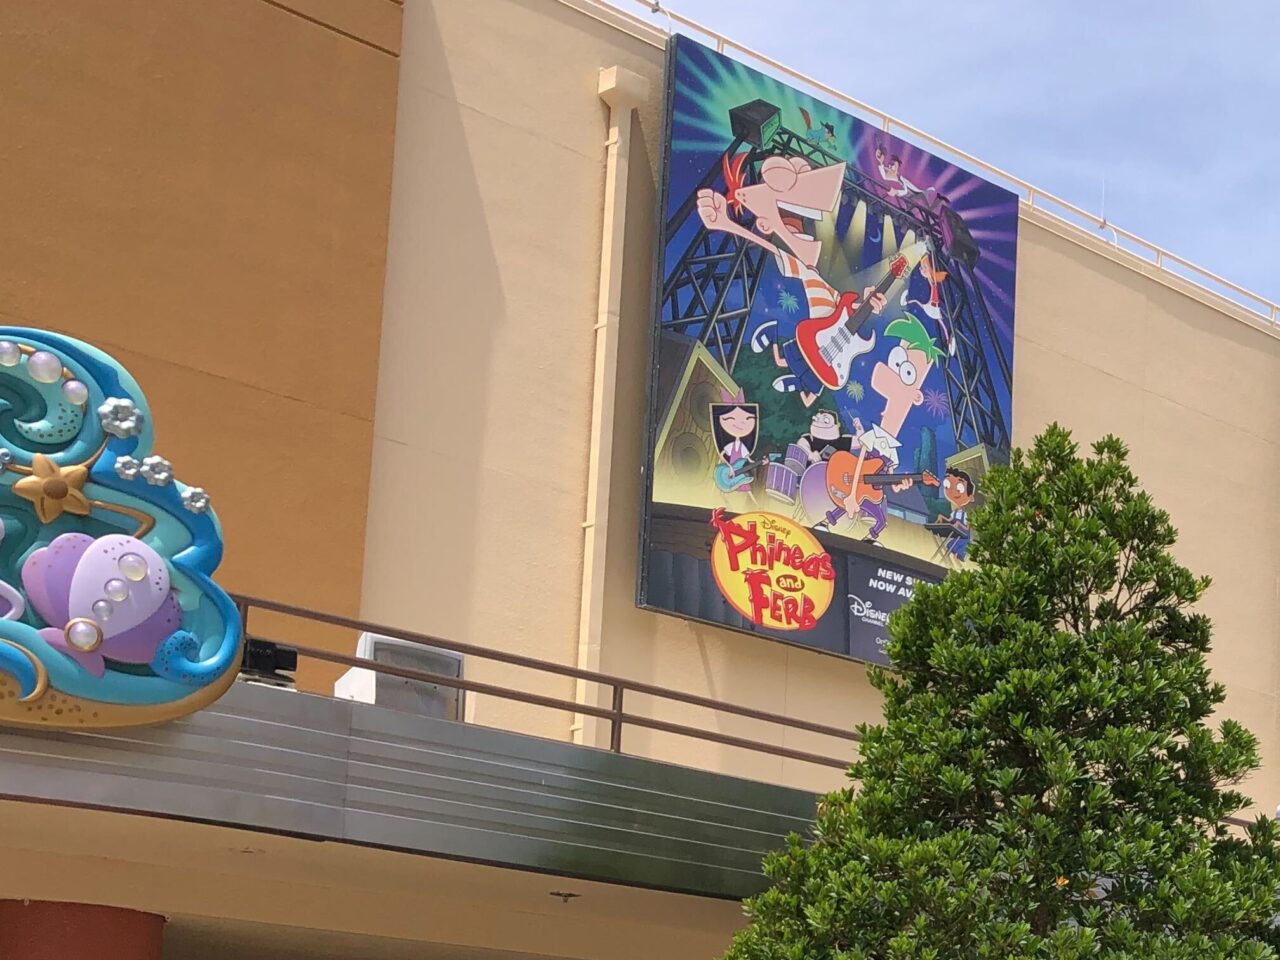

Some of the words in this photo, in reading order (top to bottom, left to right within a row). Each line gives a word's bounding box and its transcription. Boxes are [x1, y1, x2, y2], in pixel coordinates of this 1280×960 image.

[759, 515, 791, 539] Disney
[711, 507, 836, 580] Phineas
[779, 577, 802, 589] and
[877, 568, 904, 582] NEW
[868, 578, 897, 593] NOW
[848, 594, 889, 622] Disne
